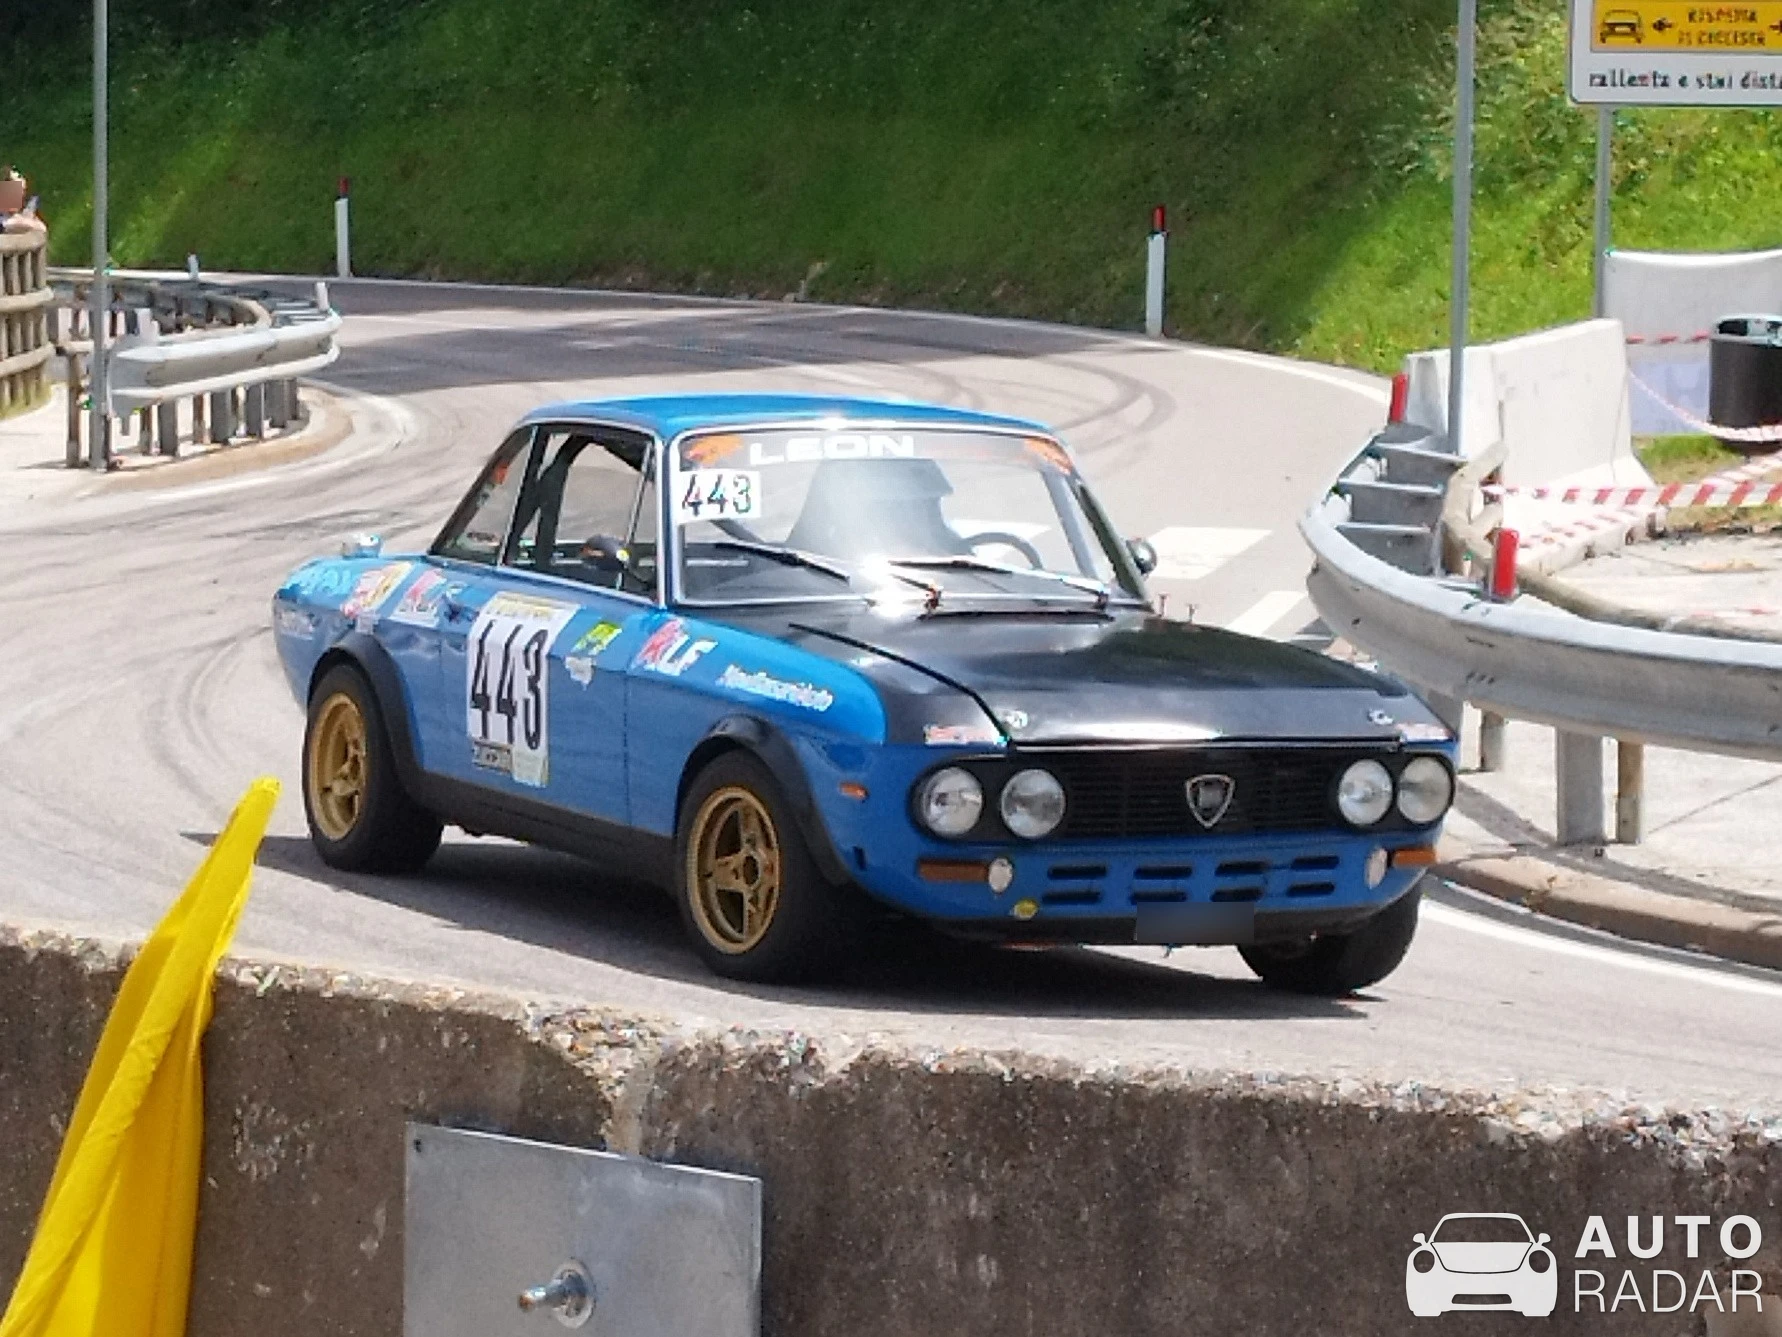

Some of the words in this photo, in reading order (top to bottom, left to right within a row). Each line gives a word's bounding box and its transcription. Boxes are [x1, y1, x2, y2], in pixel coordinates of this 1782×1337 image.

[749, 434, 915, 466] LEON
[681, 473, 752, 517] 443
[470, 619, 550, 751] 443
